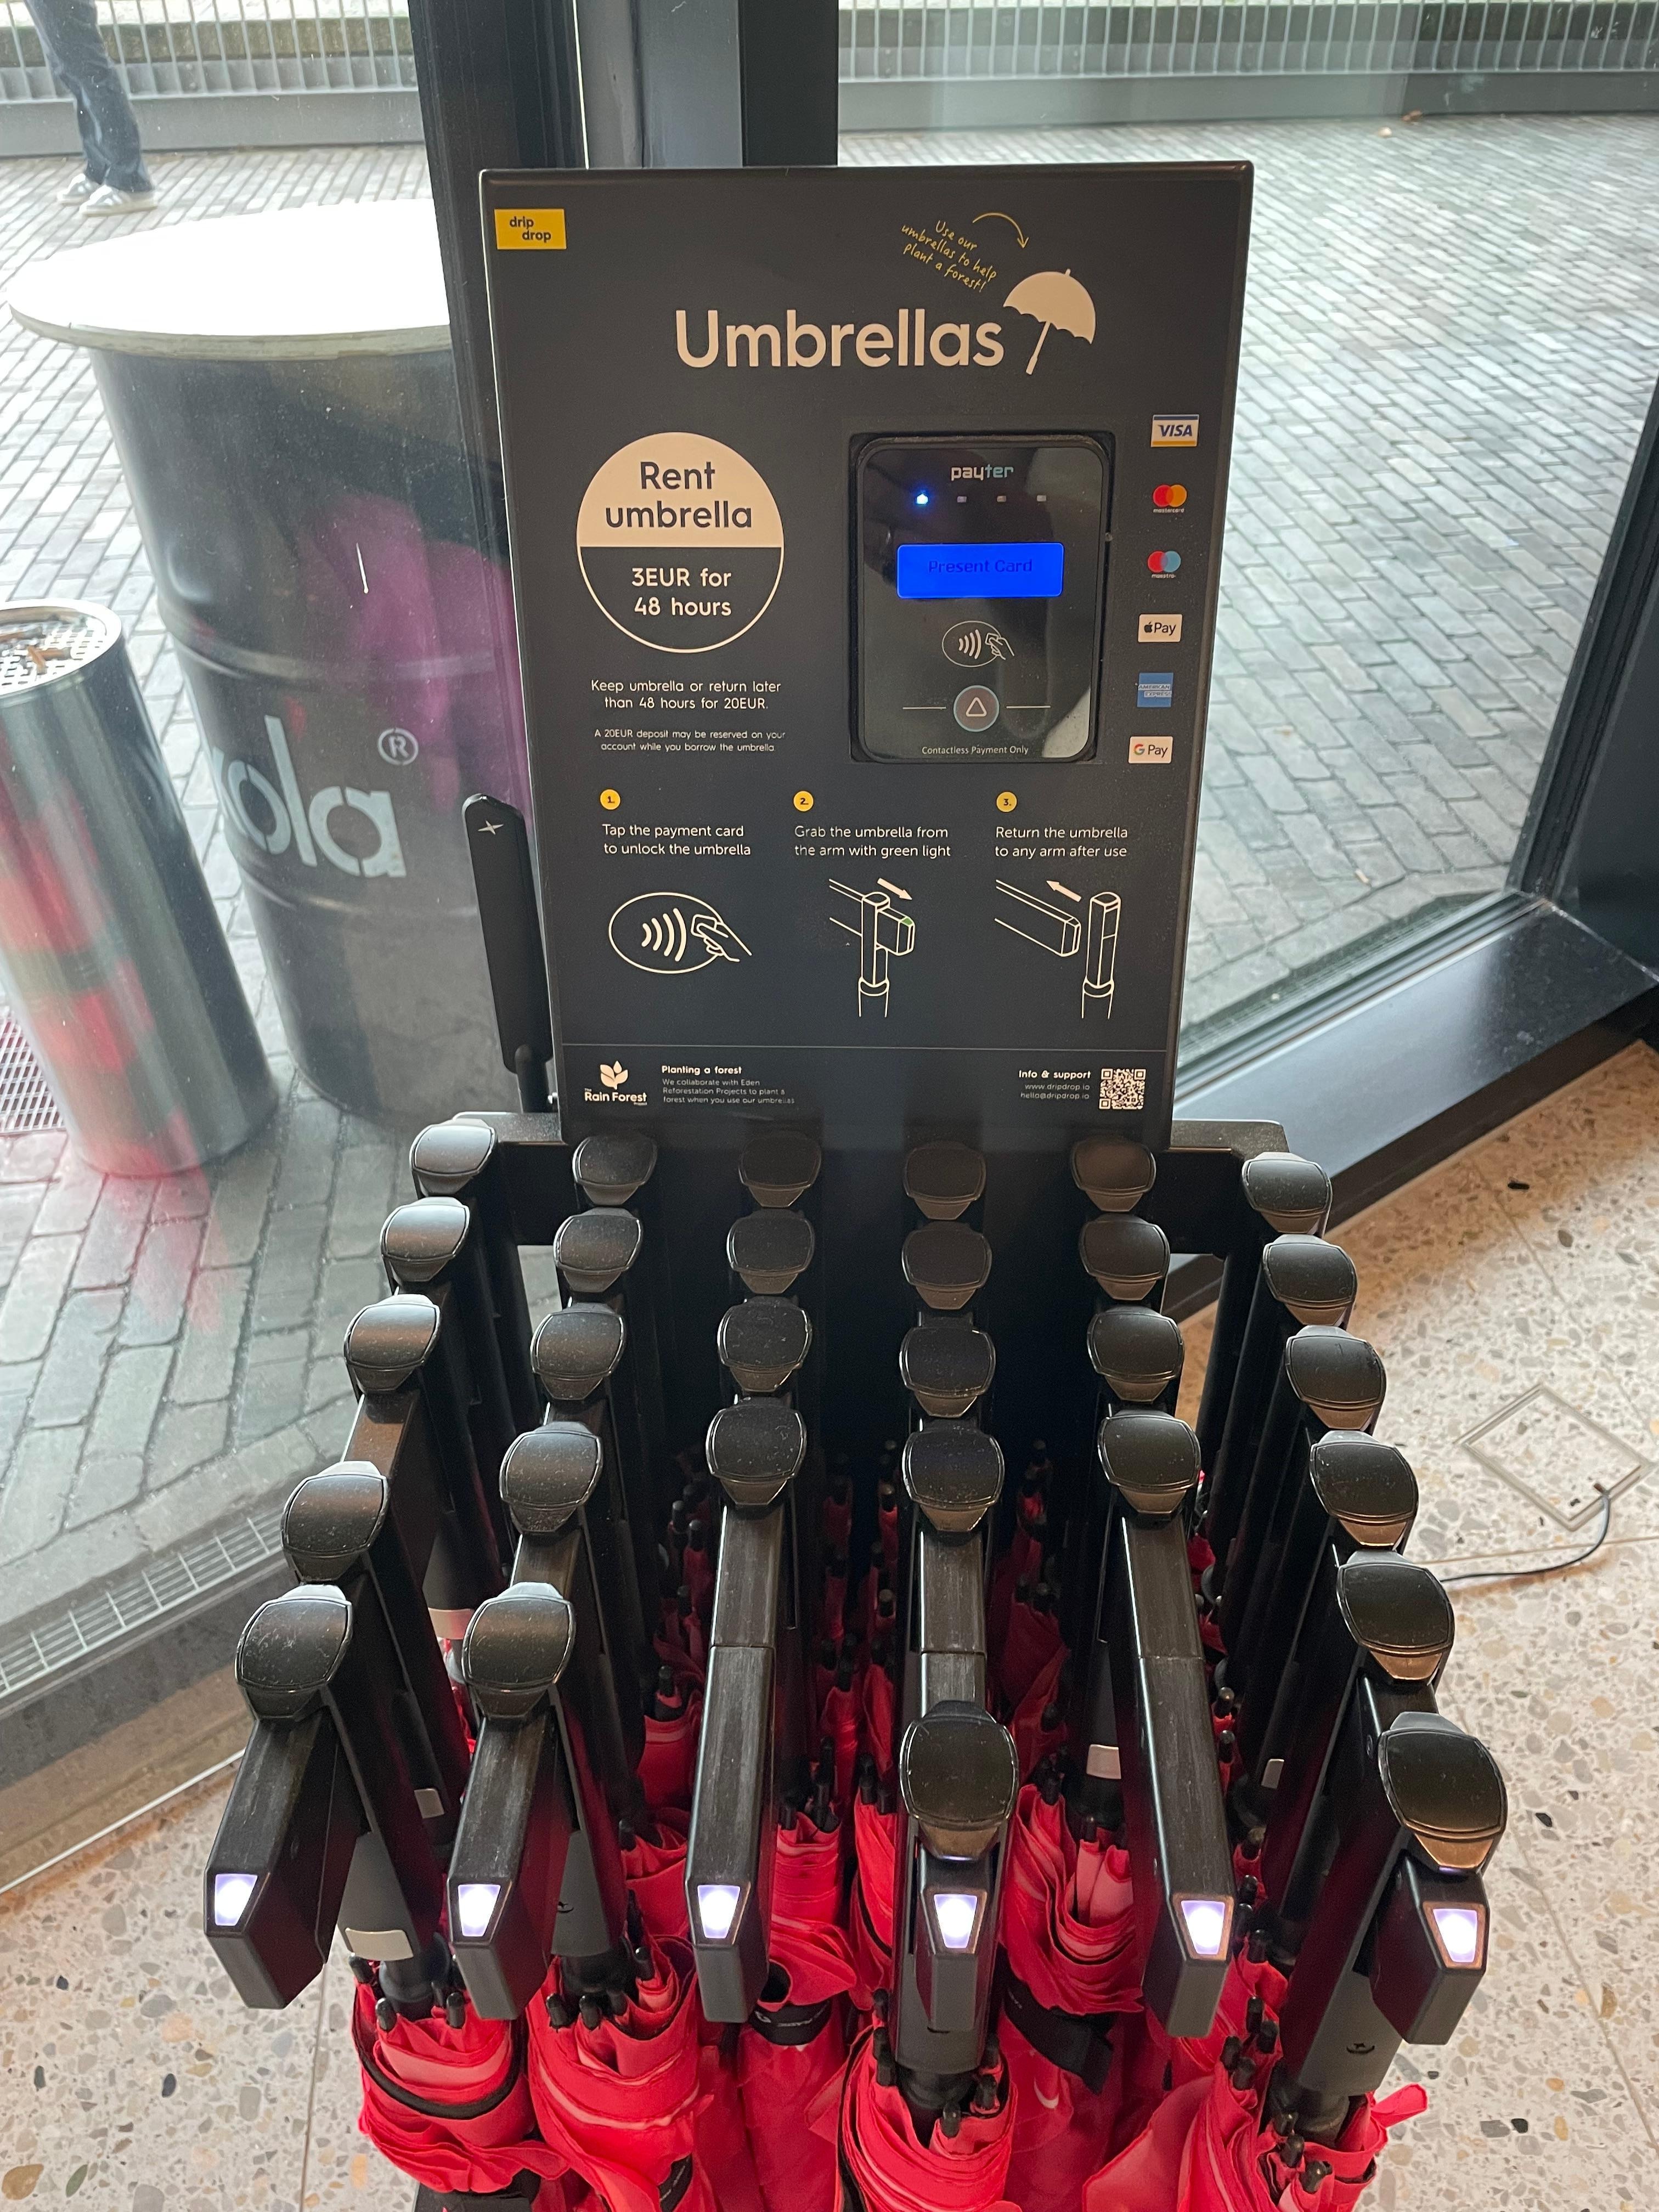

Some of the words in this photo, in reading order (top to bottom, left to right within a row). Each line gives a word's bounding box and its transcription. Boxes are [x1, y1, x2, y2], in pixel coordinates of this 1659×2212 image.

[509, 216, 534, 229] drip
[522, 230, 551, 243] drop
[935, 220, 955, 240] Use
[958, 237, 978, 251] our
[901, 225, 956, 259] umbrellas
[958, 252, 970, 267] to
[973, 258, 997, 282] help
[903, 243, 934, 264] plant
[944, 264, 986, 293] forest!
[675, 308, 1005, 368] Umbrellas
[1158, 425, 1192, 437] VISA
[640, 461, 715, 489] Rent
[951, 464, 1014, 481] payter
[606, 500, 752, 528] umbrella
[928, 560, 989, 573] Present
[995, 558, 1032, 573] Card
[631, 568, 690, 586] 3EUR
[700, 568, 732, 586] for
[634, 597, 661, 616] 48
[671, 597, 732, 616] hours
[1154, 622, 1176, 635] Pay
[591, 680, 624, 693] Keep
[630, 680, 684, 692] umbrella
[690, 682, 703, 692] or
[709, 681, 747, 692] return
[753, 681, 781, 693] later
[605, 697, 633, 708] than
[639, 697, 654, 709] 48
[661, 697, 696, 709] hours
[701, 697, 719, 709] for
[595, 729, 601, 737] A
[605, 729, 633, 738] 20EUR
[636, 730, 668, 740] deposit
[672, 731, 691, 740] may
[695, 730, 707, 738] be
[710, 731, 747, 739] reserved
[766, 732, 786, 741] your
[601, 743, 636, 751] account
[640, 743, 661, 751] while
[665, 744, 681, 753] you
[685, 743, 716, 752] borrow
[720, 743, 733, 752] the
[922, 746, 969, 755] Contactless
[972, 746, 1007, 756] Payment
[1009, 746, 1029, 755] Only
[602, 824, 625, 838] Tap
[630, 825, 650, 836] the
[654, 826, 712, 838] payment
[715, 826, 744, 837] card
[794, 826, 826, 838] Grab
[830, 826, 851, 838] the
[855, 826, 912, 838] umbrella
[917, 826, 948, 838] from
[996, 826, 1039, 838] Return
[1044, 826, 1065, 838] the
[1069, 826, 1128, 838] umbrella
[604, 843, 618, 854] to
[622, 843, 665, 854] unlock
[669, 843, 690, 855] the
[695, 844, 751, 855] umbrella
[794, 845, 815, 856] the
[820, 847, 845, 856] arm
[849, 845, 876, 856] with
[881, 847, 918, 859] green
[923, 845, 951, 859] light
[995, 846, 1008, 857] to
[1012, 848, 1036, 859] any
[1040, 848, 1065, 857] arm
[1069, 845, 1100, 857] after
[1104, 848, 1127, 857] use
[662, 1065, 701, 1075] Planting
[715, 1066, 742, 1074] forest
[1019, 1070, 1037, 1078] Info
[1053, 1071, 1091, 1080] support
[585, 1092, 610, 1101] Rain
[612, 1092, 647, 1102] Forest
